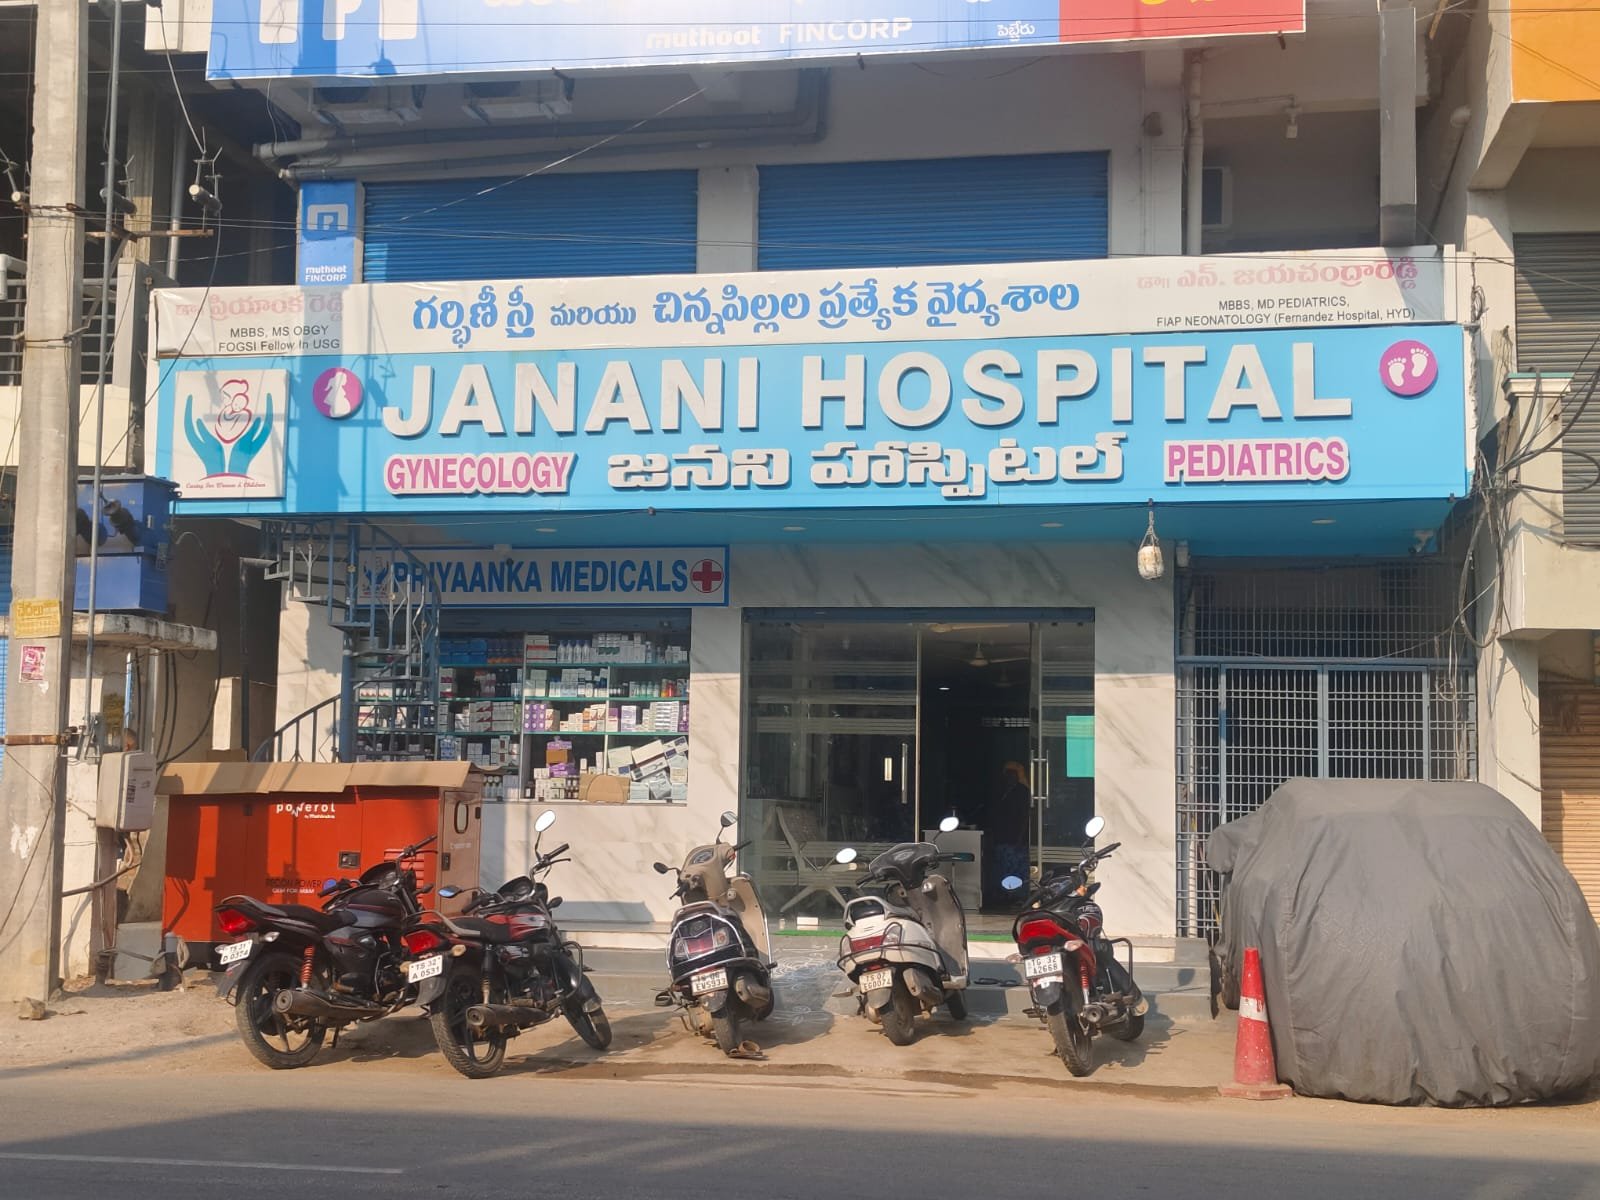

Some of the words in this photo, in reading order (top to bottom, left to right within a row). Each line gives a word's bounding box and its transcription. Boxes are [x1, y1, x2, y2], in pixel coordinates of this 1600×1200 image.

[646, 25, 762, 49] muthoot
[778, 17, 913, 45] FINCORP
[304, 273, 347, 283] FINCORP
[305, 264, 347, 275] muthoot
[549, 302, 637, 326] మరియు
[652, 283, 811, 335] చిన్నపిల్లల
[817, 277, 919, 331] ప్రత్యేక
[925, 278, 1080, 328] వైద్యశాల
[1156, 317, 1182, 327] FIAP
[1184, 313, 1271, 326] NEONATOLOGY
[1274, 311, 1334, 324] (Fernandez
[1337, 309, 1384, 322] Hospital,
[1386, 307, 1416, 321] HYD)
[1218, 299, 1254, 312] MBBS,
[1257, 299, 1275, 309] MD
[1278, 296, 1350, 309] PEDIATRICS,
[218, 342, 257, 352] FOGSI
[260, 340, 296, 351] Fellow
[312, 339, 341, 349] USG
[230, 328, 269, 339] MBBS,
[272, 327, 290, 337] MS
[293, 325, 329, 336] OBGY
[382, 356, 760, 438] JANANI
[801, 341, 1353, 430] HOSPITAL
[386, 454, 570, 491] GYNECOLOGY
[607, 443, 792, 490] జనని
[810, 432, 1128, 499] హాస్పిటల్
[1167, 440, 1346, 479] PEDIATRICS
[393, 560, 542, 593] PRIYAANKA
[550, 559, 689, 593] MEDICALS
